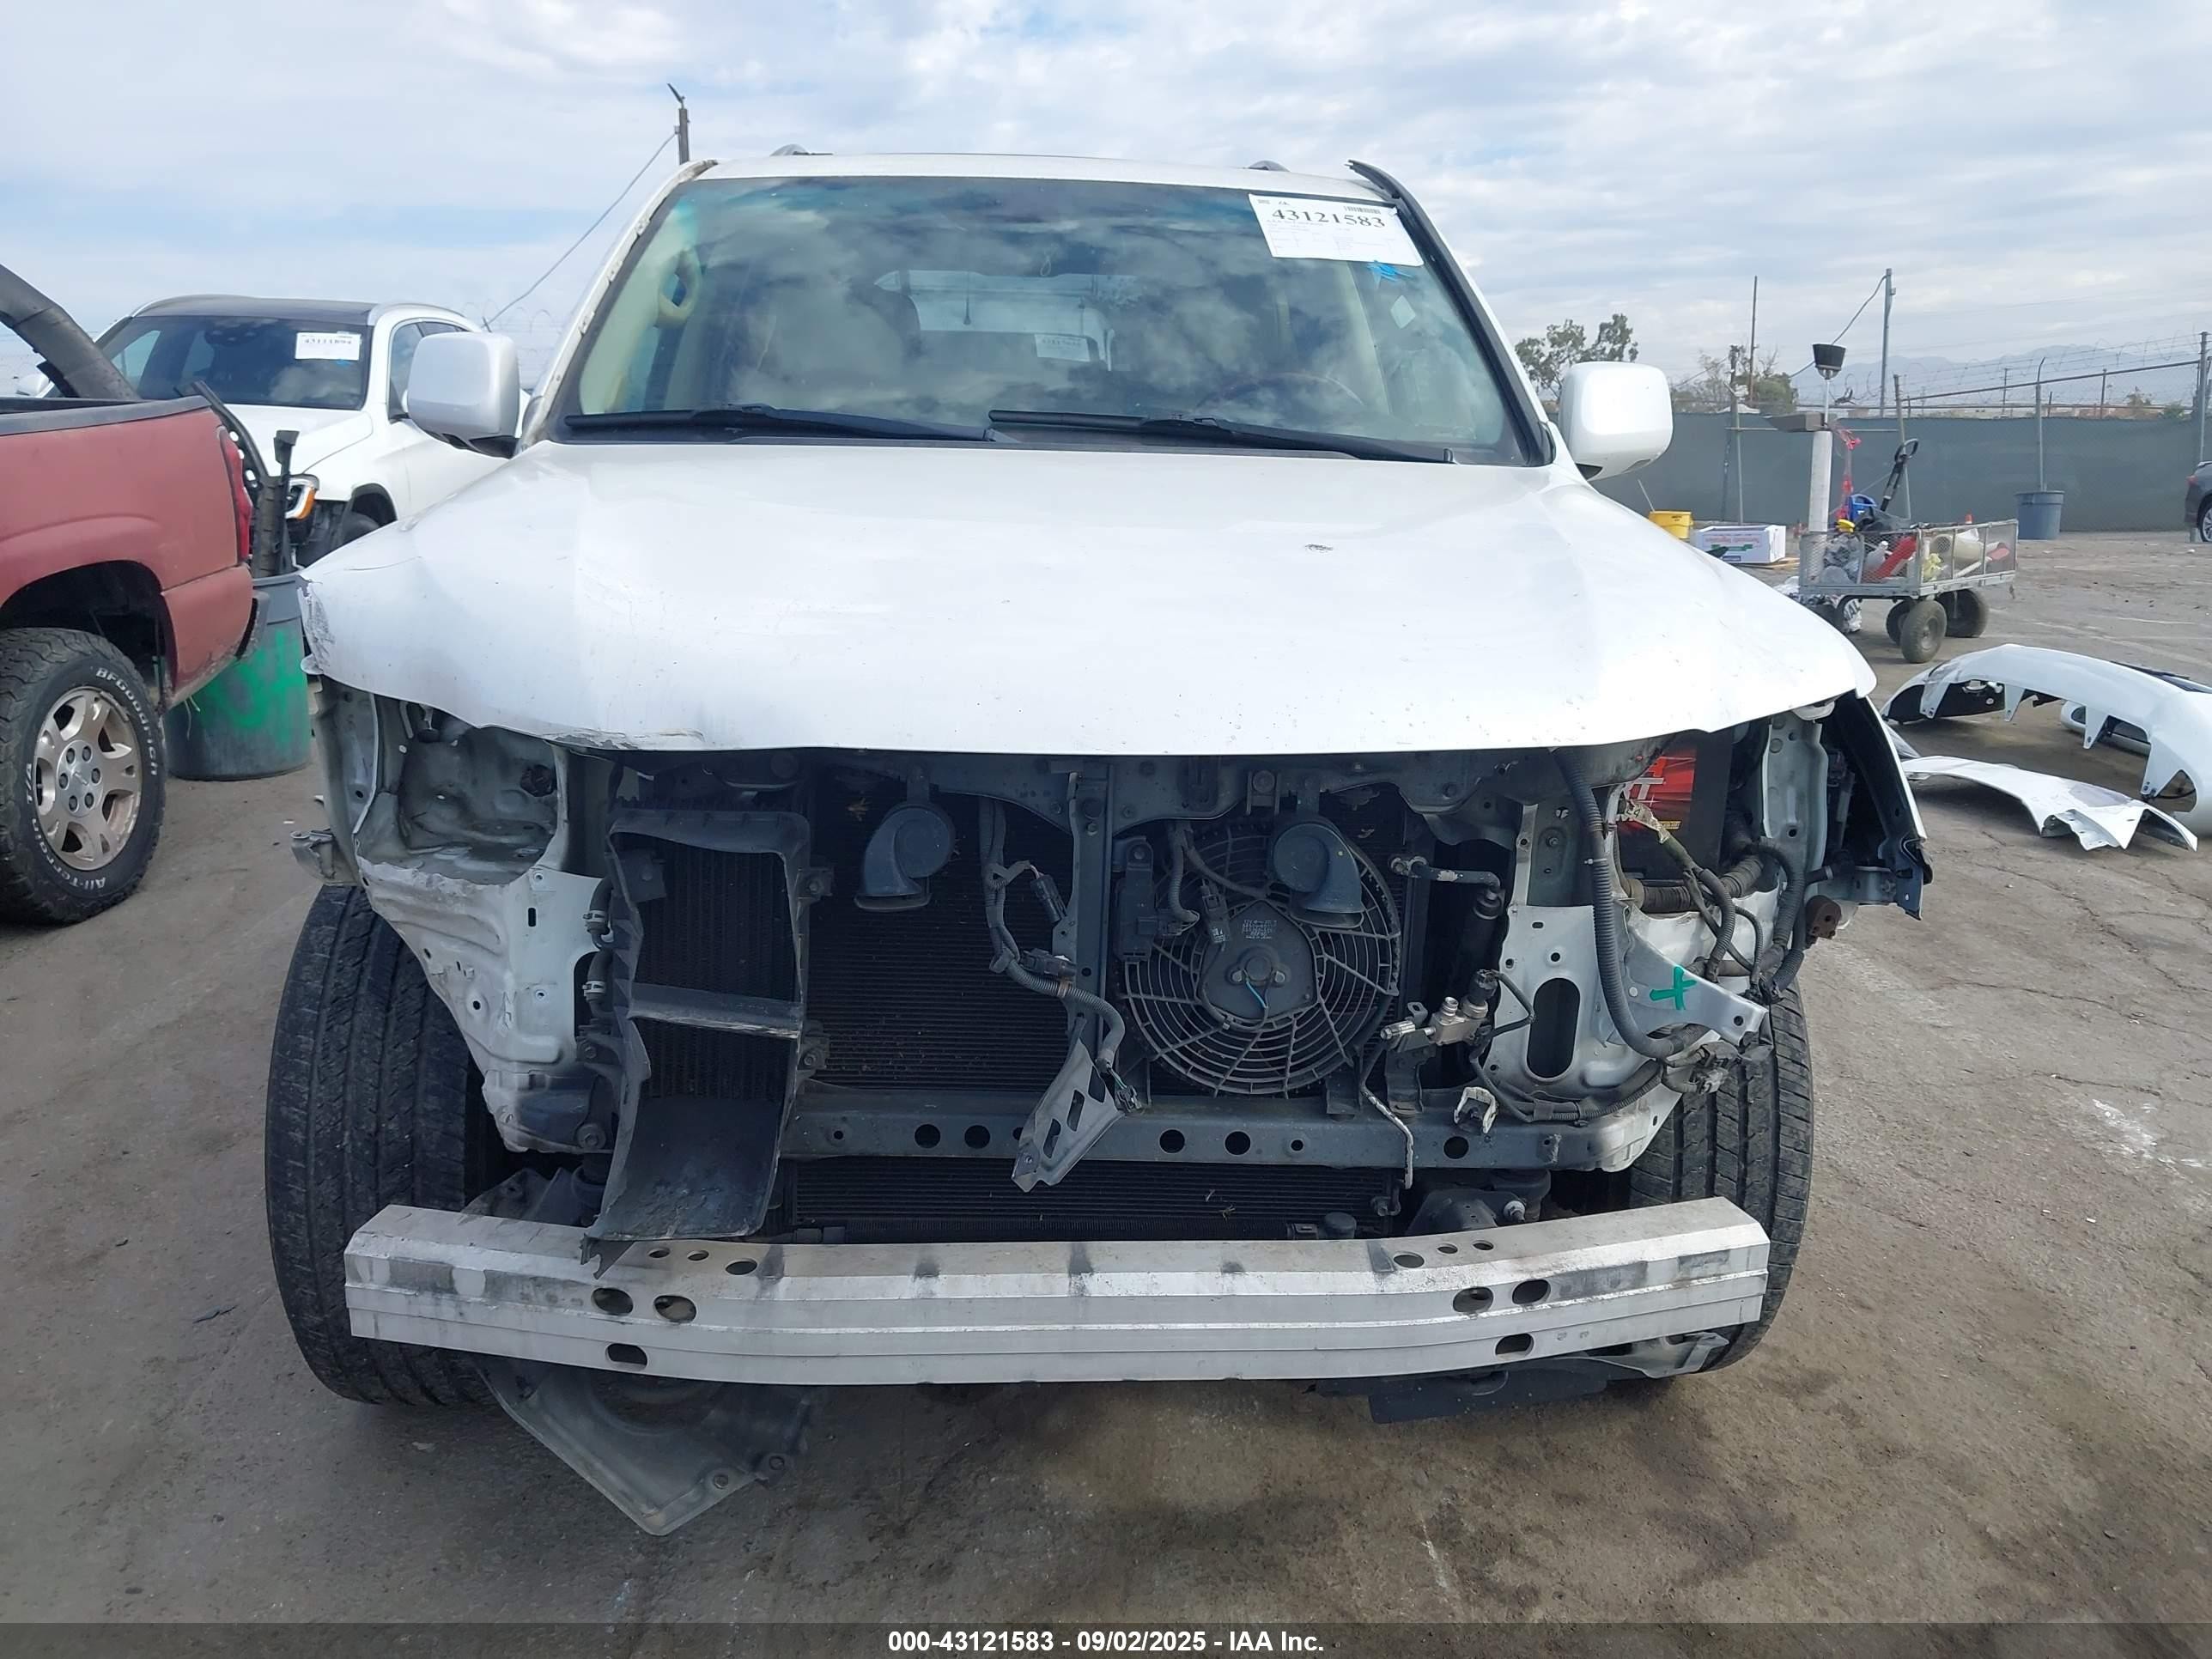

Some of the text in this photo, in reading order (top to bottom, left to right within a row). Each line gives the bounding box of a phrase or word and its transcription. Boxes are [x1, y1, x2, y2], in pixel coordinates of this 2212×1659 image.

[1272, 208, 1386, 228] 43121583
[96, 667, 158, 775] BFGoodrich
[32, 817, 106, 890] All-Terrain
